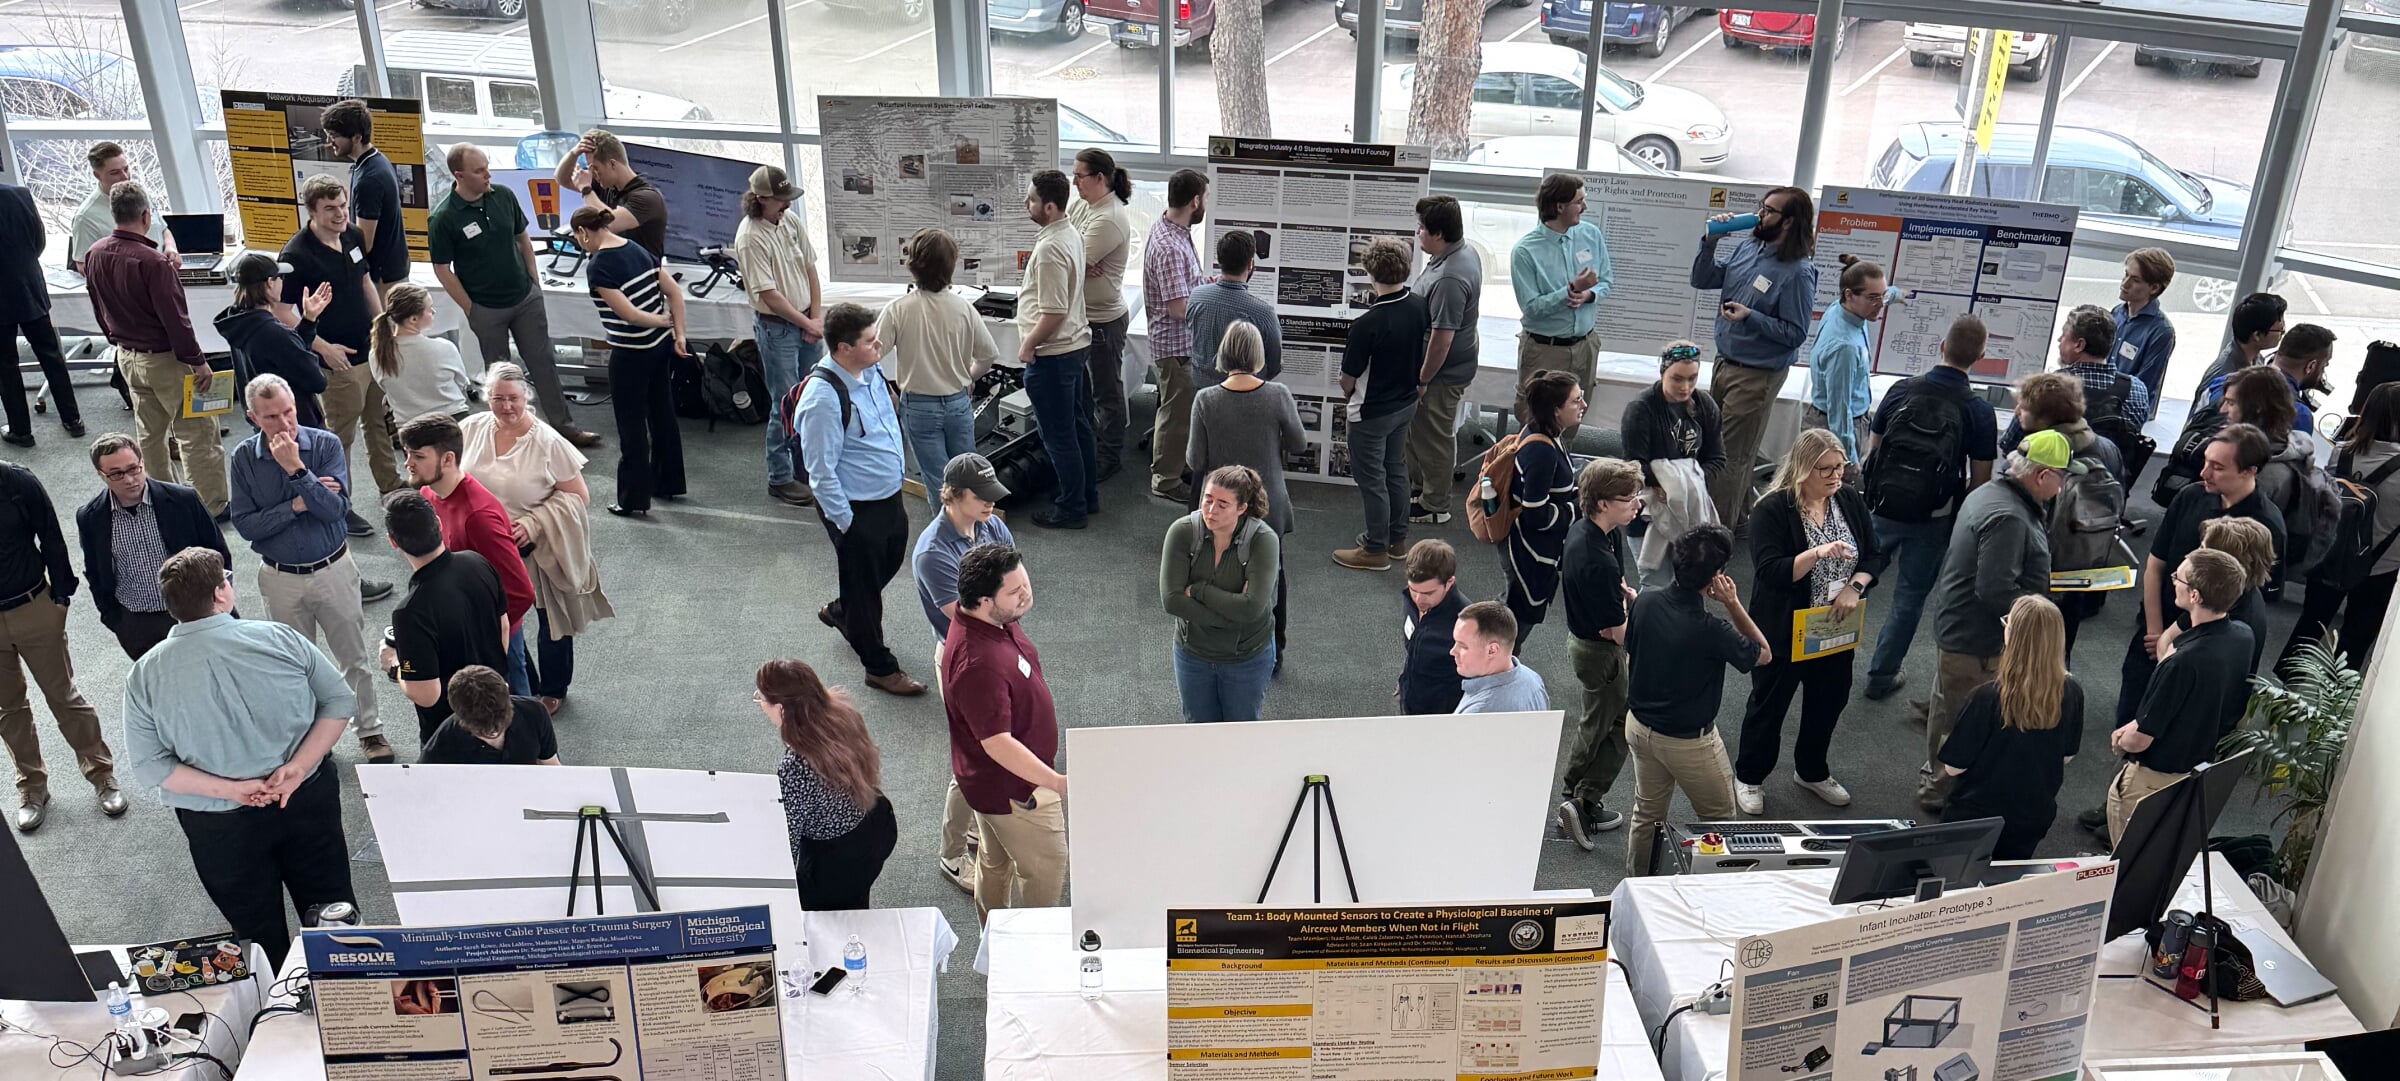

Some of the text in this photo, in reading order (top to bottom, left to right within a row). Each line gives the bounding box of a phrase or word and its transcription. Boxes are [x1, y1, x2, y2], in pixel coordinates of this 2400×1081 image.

[267, 93, 335, 105] Network Acquisition
[1239, 143, 1269, 151] Integrating
[1269, 144, 1292, 152] Industry
[1304, 145, 1333, 153] Standards
[1366, 149, 1390, 157] Foundry
[1604, 186, 1628, 196] Rights
[1630, 188, 1645, 197] and
[1647, 189, 1687, 200] Protection
[2032, 211, 2060, 219] THERMO
[1840, 217, 1877, 228] Problem
[1902, 232, 1930, 240] Structure
[1909, 223, 1979, 237] Implementation
[1996, 229, 2061, 244] Benchmarking
[1989, 239, 2016, 248] Methods
[1285, 319, 1315, 327] Standards
[2076, 866, 2115, 880] PLEXUS
[1226, 912, 1252, 921] Team
[1255, 912, 1264, 921] 1:
[1266, 911, 1291, 922] Body
[1294, 911, 1338, 921] Mounted
[1341, 911, 1379, 921] Sensors
[1381, 911, 1391, 920] to
[1393, 910, 1425, 920] Create
[1435, 908, 1498, 920] Physiological
[1500, 907, 1541, 917] Baseline
[1543, 906, 1554, 915] of
[1859, 896, 1993, 934] Infant Incubator: Prototype 3
[2067, 908, 2089, 918] Sensor
[687, 915, 740, 927] Michigan
[401, 919, 672, 943] Minimally-Invasive Cable Passer for Trauma Surgery
[688, 921, 765, 936] Technological
[1300, 922, 1479, 934] Aircrew Members When Not in Flight
[689, 932, 747, 945] University
[1219, 947, 1265, 955] Engineering
[328, 952, 396, 964] RESOLVE
[1326, 958, 1450, 968] Materials and Methods (Continued)
[1516, 956, 1553, 964] Discussion
[1554, 954, 1595, 964] (Continued)
[1221, 962, 1263, 970] Background
[1779, 1021, 1803, 1032] Heating
